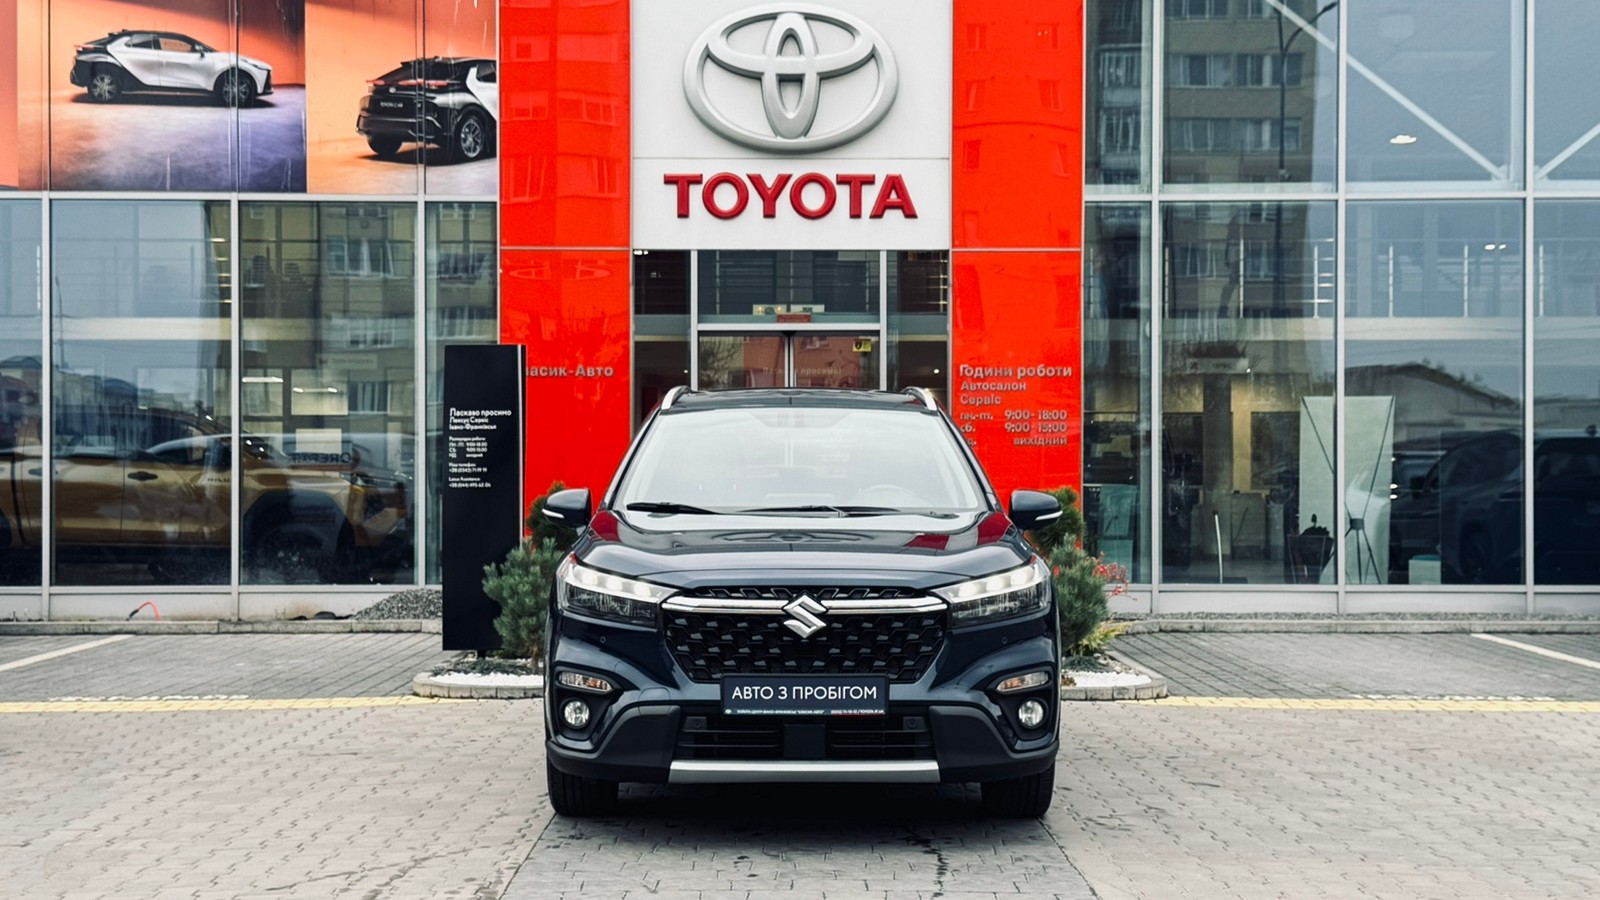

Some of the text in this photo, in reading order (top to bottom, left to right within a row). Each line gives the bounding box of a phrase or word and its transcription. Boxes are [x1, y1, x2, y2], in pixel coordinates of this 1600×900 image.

[664, 172, 918, 219] TOYOTA
[525, 363, 614, 377] асик-Авто
[959, 363, 1073, 379] Години роботи
[960, 380, 1027, 391] Автосалон
[960, 393, 1002, 407] Сервіс
[449, 407, 480, 417] Ласкаво
[1013, 435, 1067, 446] вихідний
[731, 686, 774, 700] АВТО
[792, 686, 877, 700] ПРОБІГОМ
